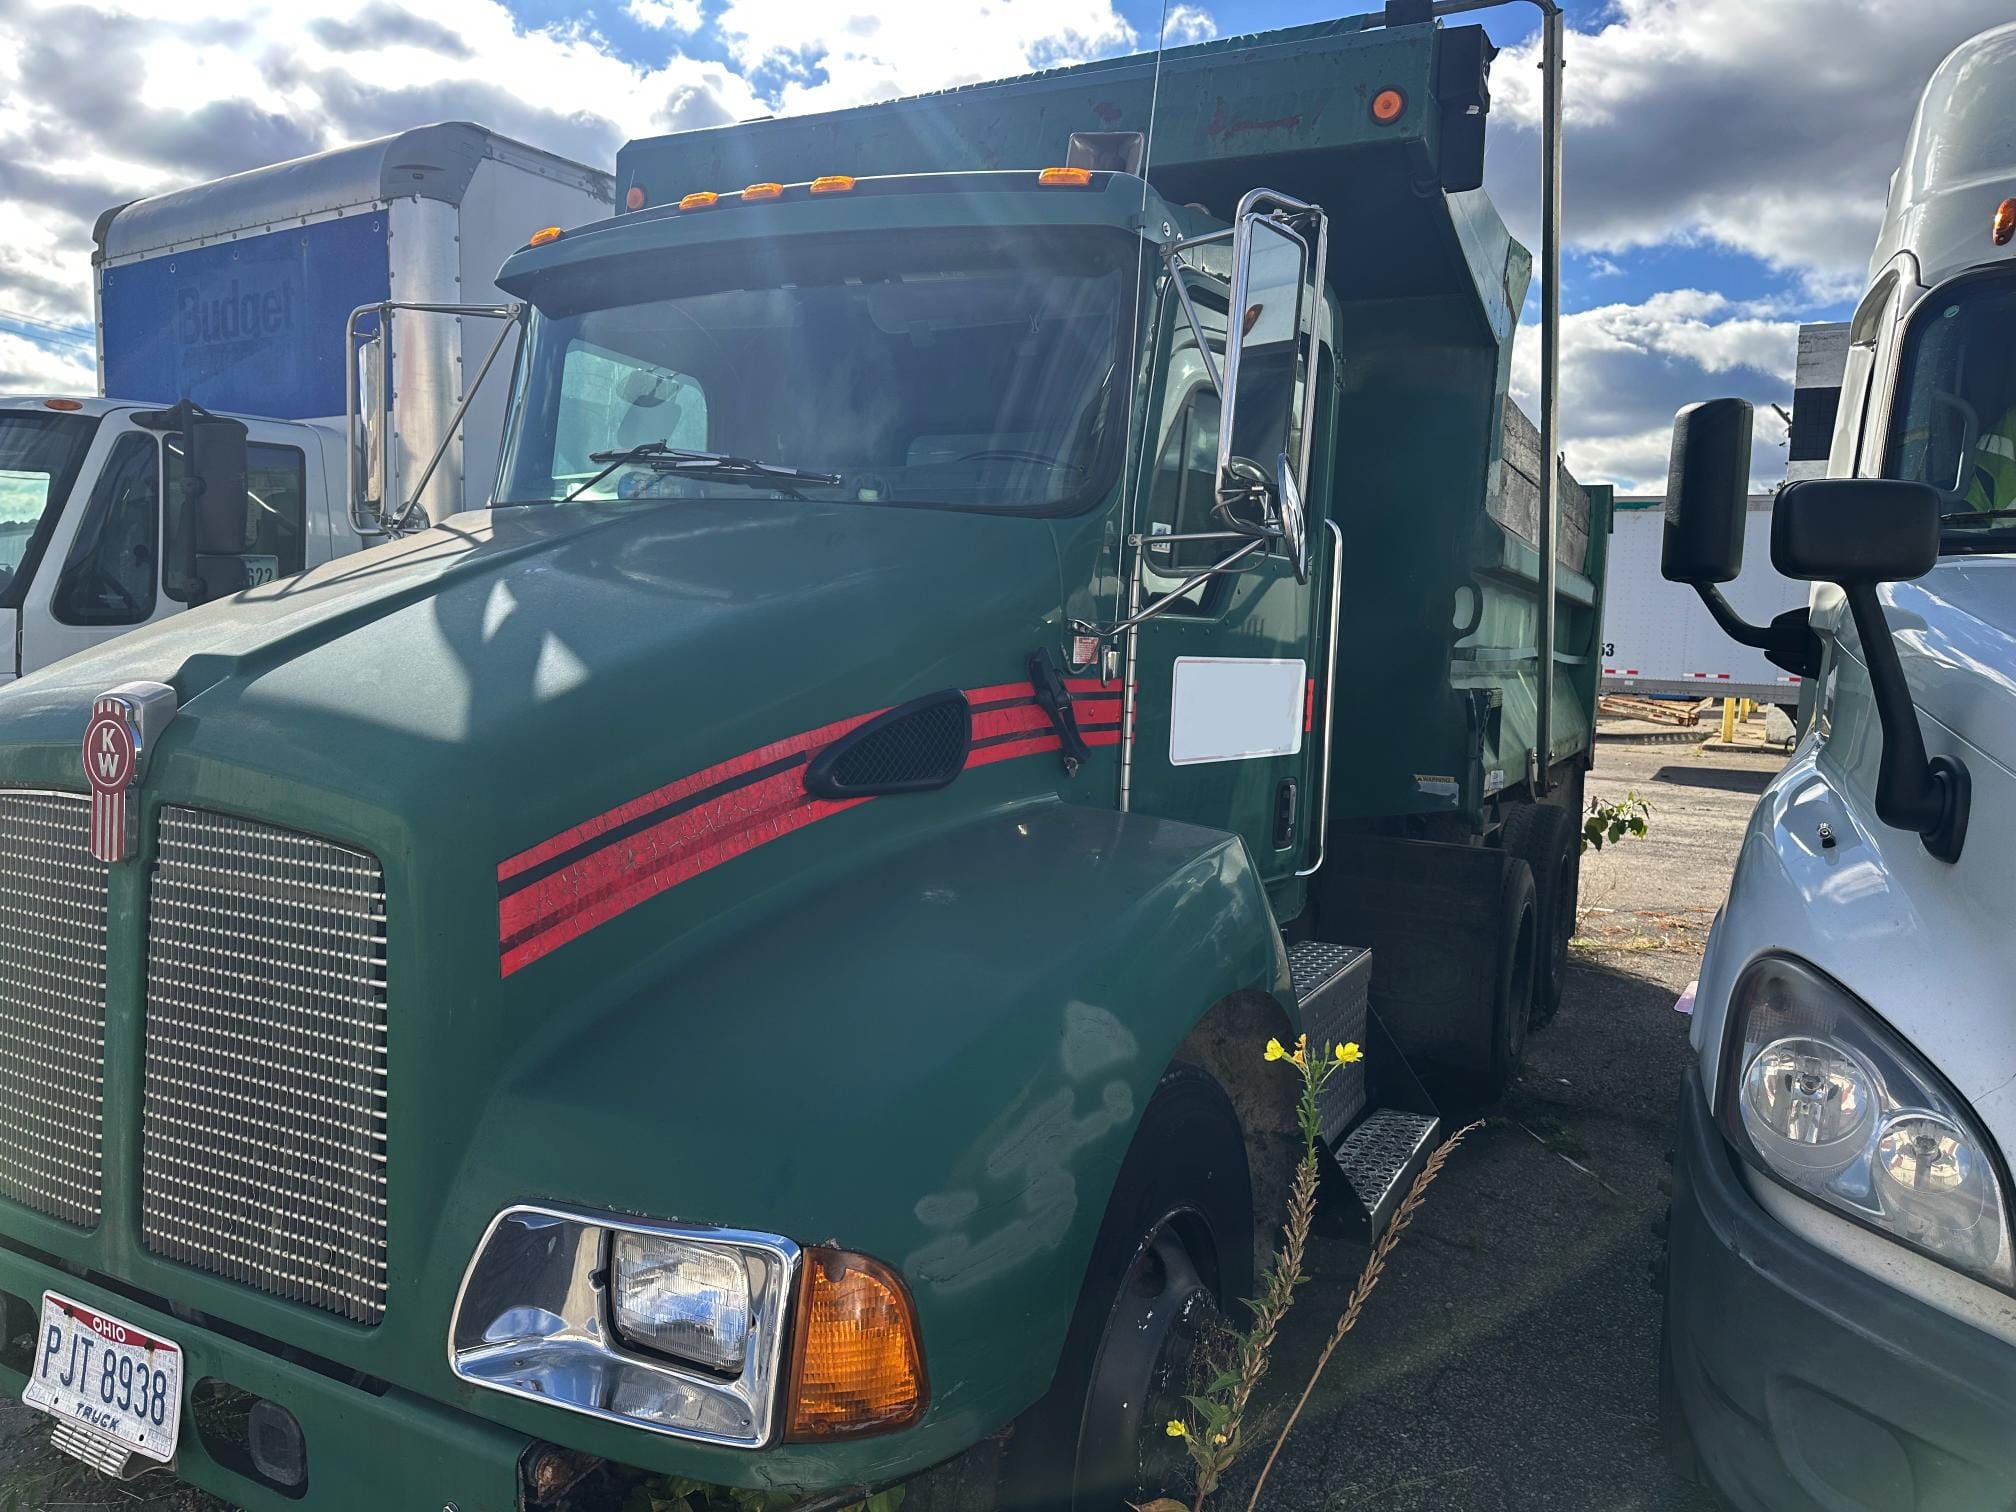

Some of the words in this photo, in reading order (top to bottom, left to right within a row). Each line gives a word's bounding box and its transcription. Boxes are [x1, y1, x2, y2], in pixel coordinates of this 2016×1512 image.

[177, 279, 295, 344] Budget
[92, 1316, 126, 1343] OHIO
[42, 1324, 94, 1394] PJT
[100, 1348, 167, 1426] 8938
[75, 1402, 120, 1432] TRUCK
